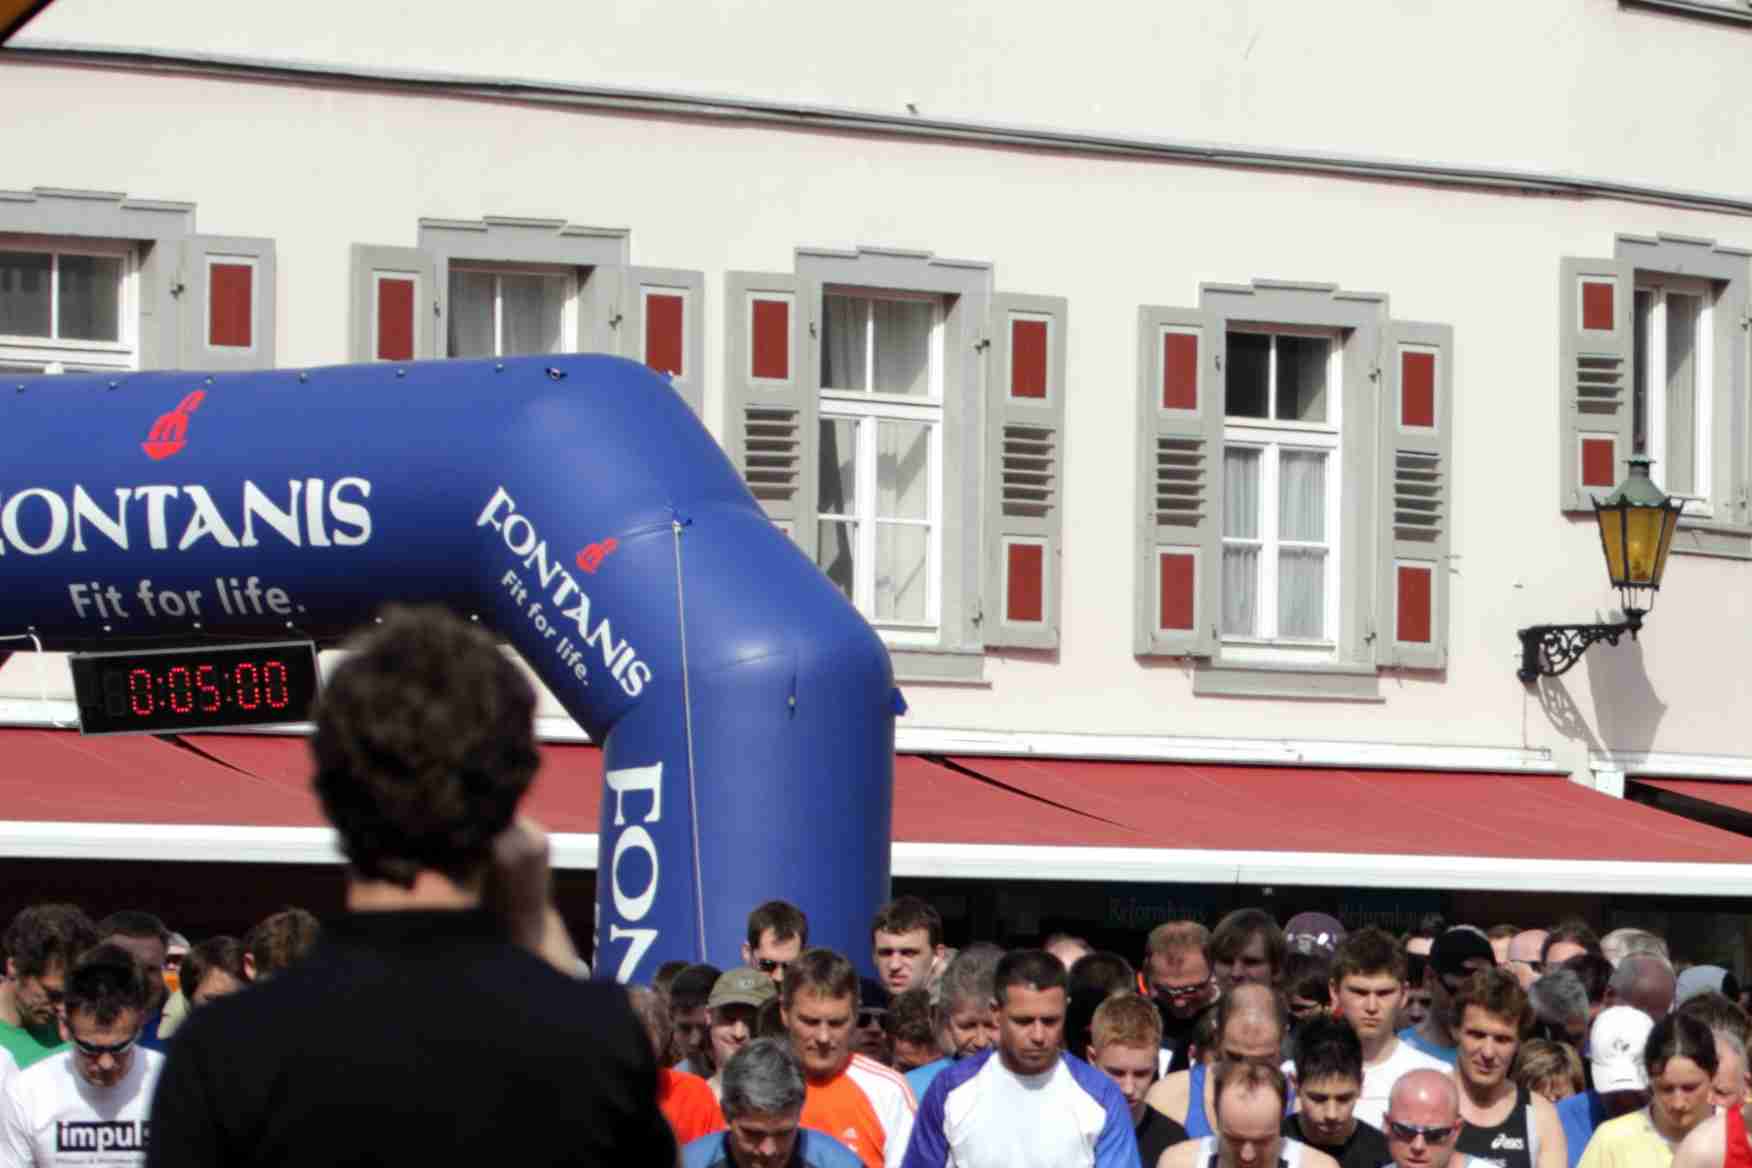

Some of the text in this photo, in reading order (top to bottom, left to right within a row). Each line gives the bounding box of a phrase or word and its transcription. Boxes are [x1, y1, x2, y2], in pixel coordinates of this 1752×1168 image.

[0, 477, 372, 555] ONTANIS
[68, 576, 305, 619] Fit for life.
[476, 485, 652, 697] FONTANIS
[502, 569, 528, 606] Fit
[528, 603, 557, 638] for
[129, 661, 289, 715] 0:05:00
[62, 1120, 150, 1151] impul
